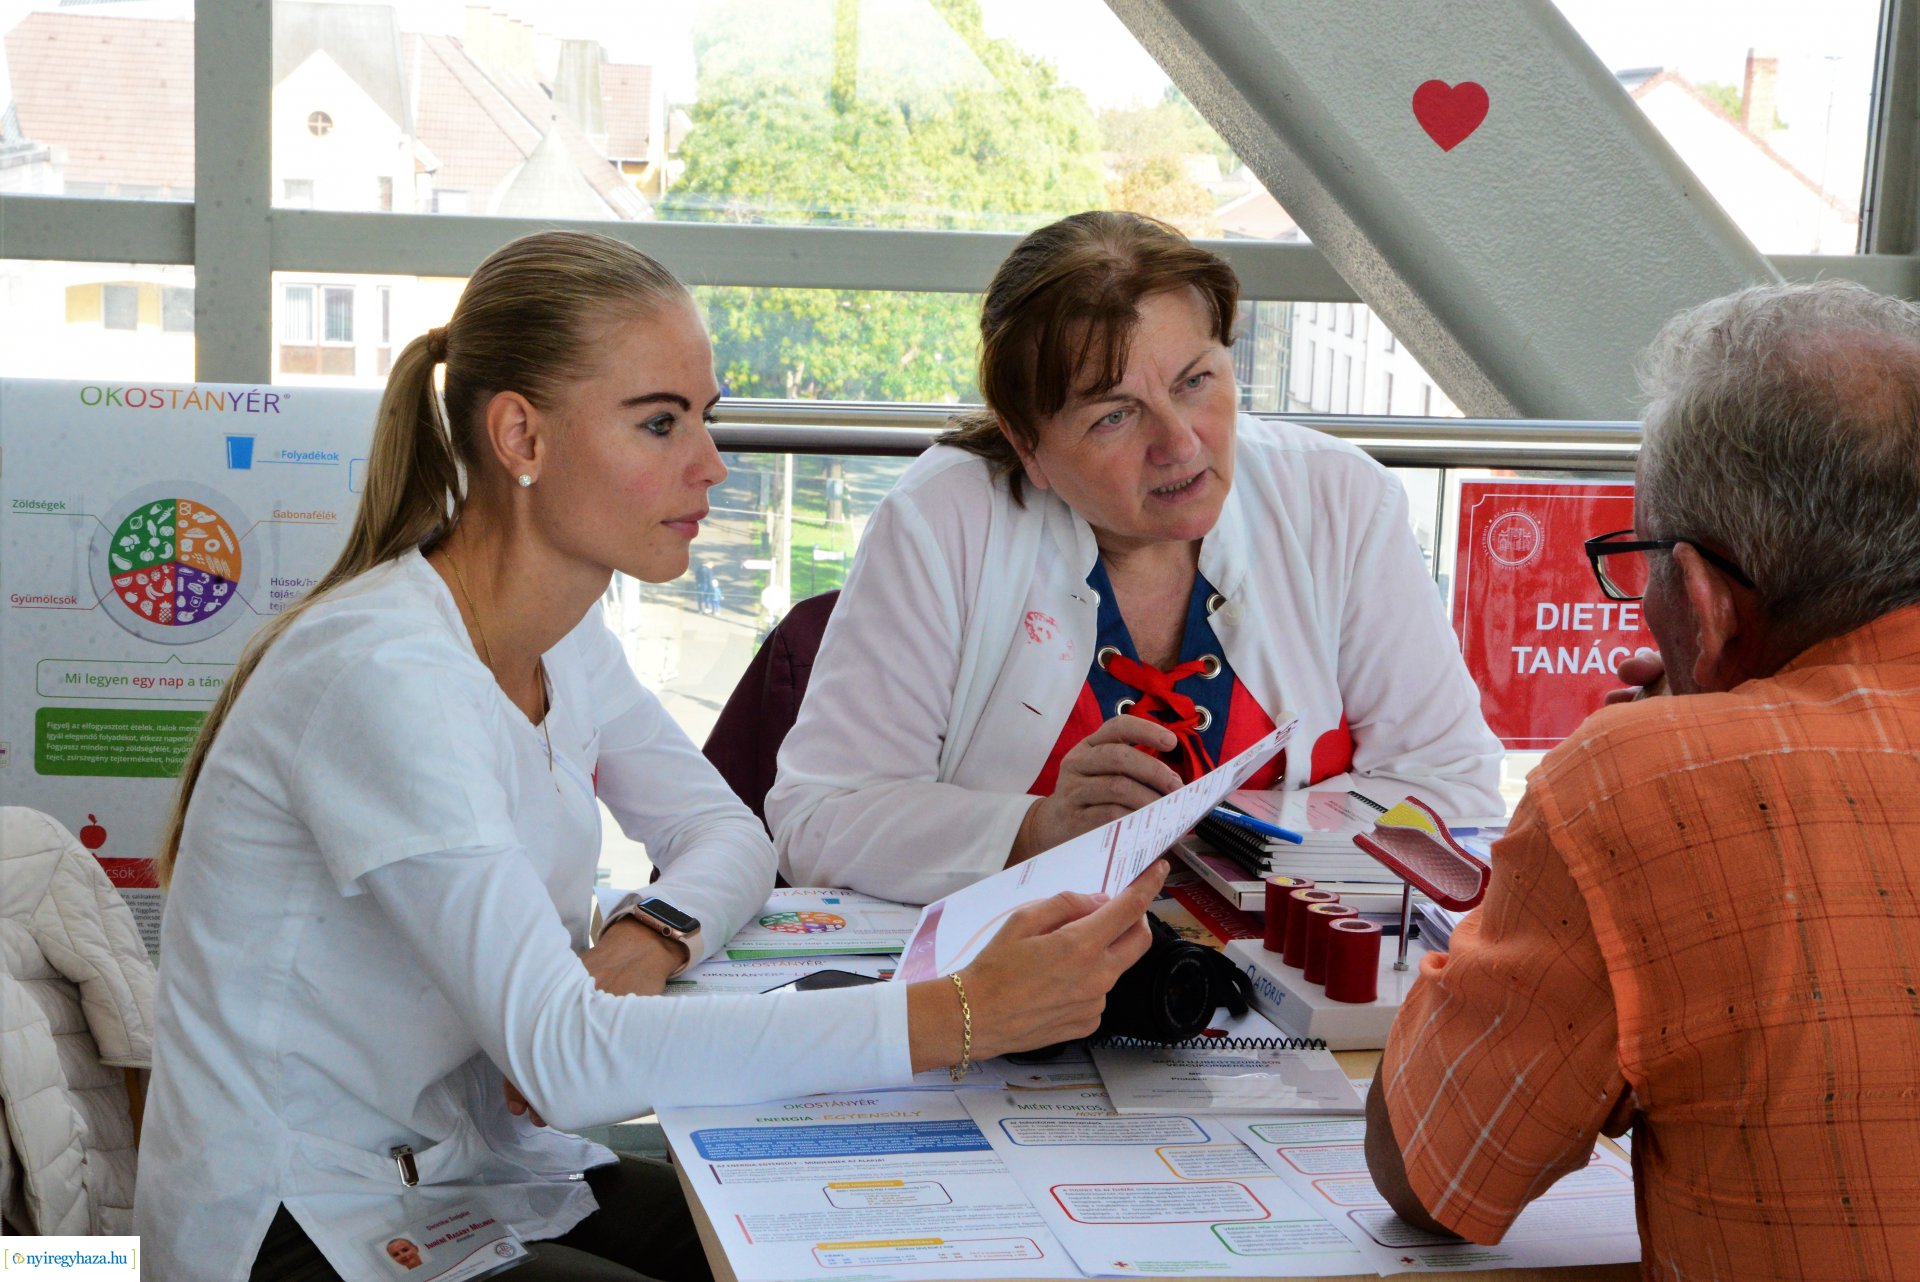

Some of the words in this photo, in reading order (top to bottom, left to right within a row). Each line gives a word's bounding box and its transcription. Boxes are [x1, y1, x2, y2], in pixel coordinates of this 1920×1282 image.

[281, 450, 340, 463] Folyadékok
[12, 499, 66, 511] Zöldségek
[272, 509, 338, 521] Gabonafélék
[10, 593, 78, 606] Gyümölcsök
[1535, 602, 1640, 631] DIETE
[65, 672, 81, 684] Mi
[86, 673, 129, 688] legyen
[132, 675, 155, 689] egy
[159, 676, 184, 690] nap
[187, 677, 196, 687] a
